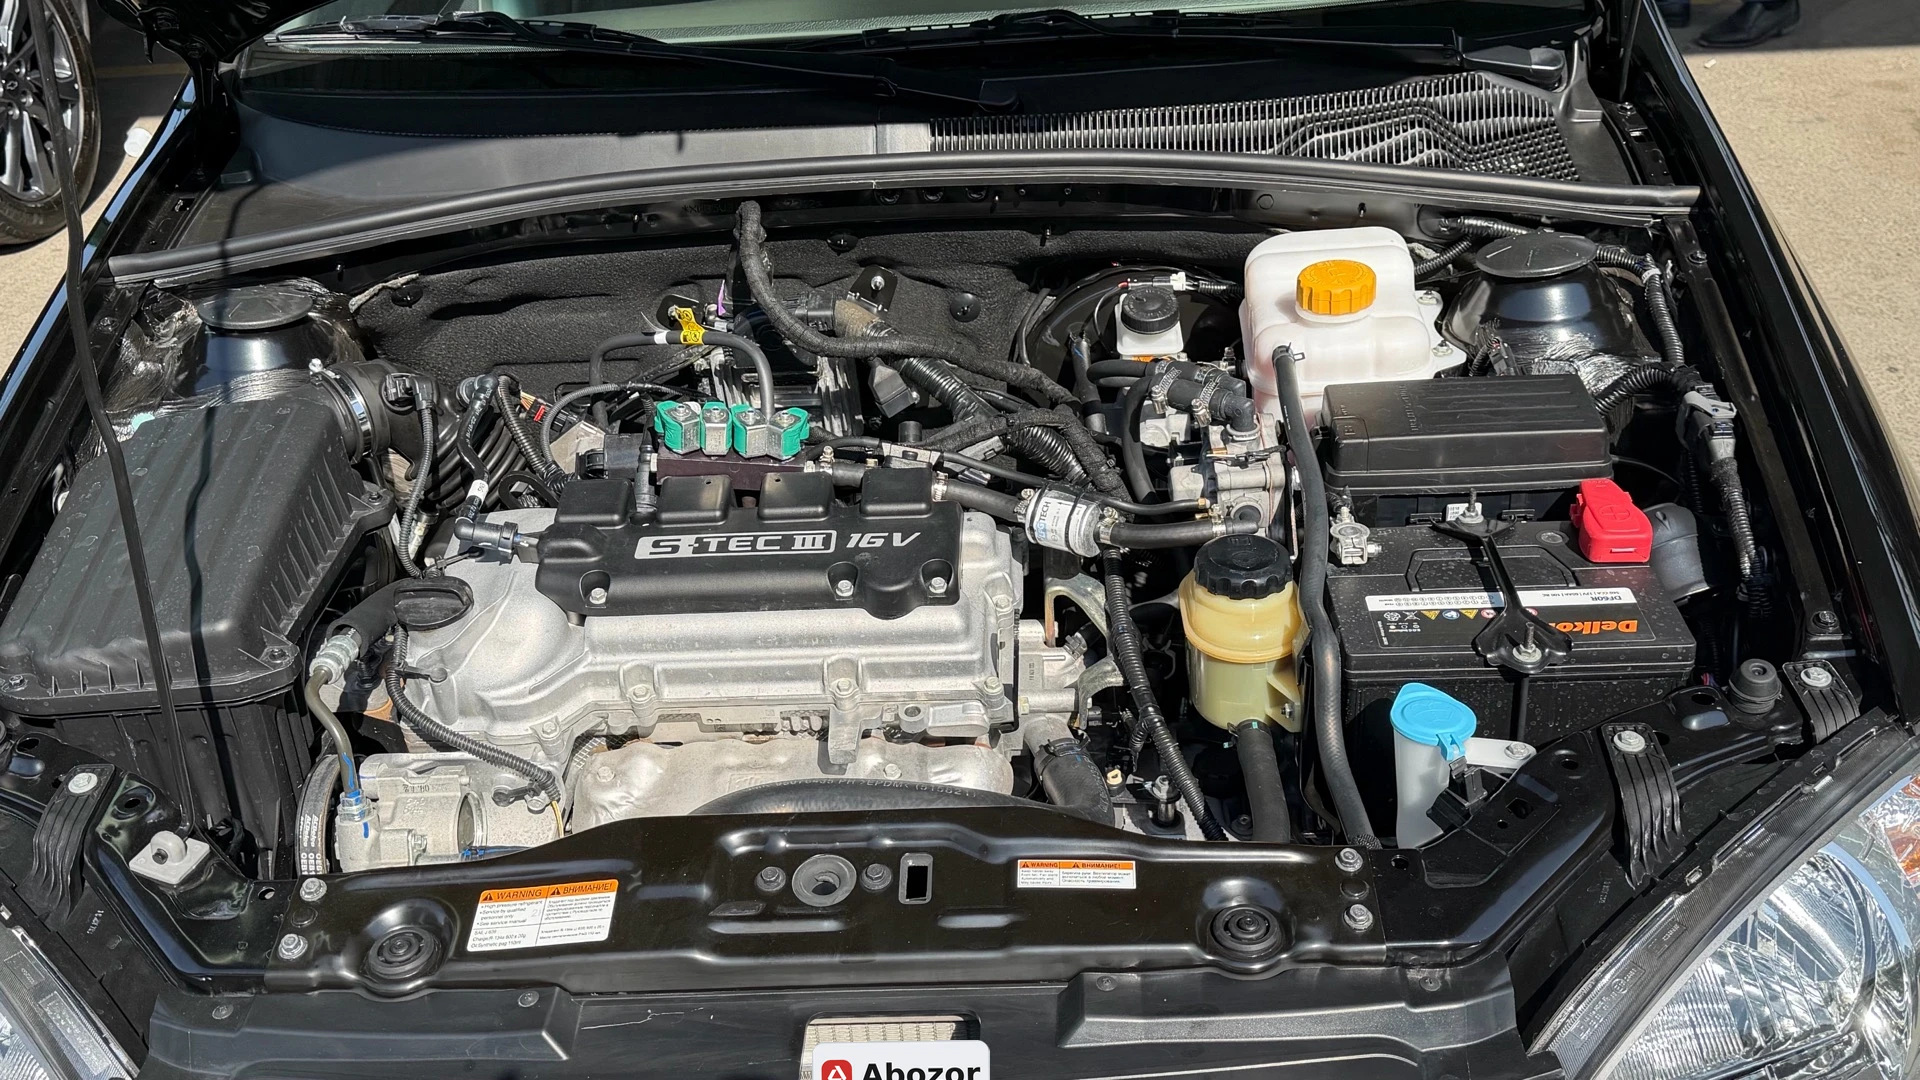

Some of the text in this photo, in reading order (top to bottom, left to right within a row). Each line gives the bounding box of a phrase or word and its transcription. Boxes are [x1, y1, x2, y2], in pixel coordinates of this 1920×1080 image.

[791, 534, 827, 550] III
[846, 532, 920, 548] 16V
[1549, 620, 1638, 634] Delko
[496, 890, 542, 900] WARNING
[563, 883, 612, 894] ВНИМАНИЕ!
